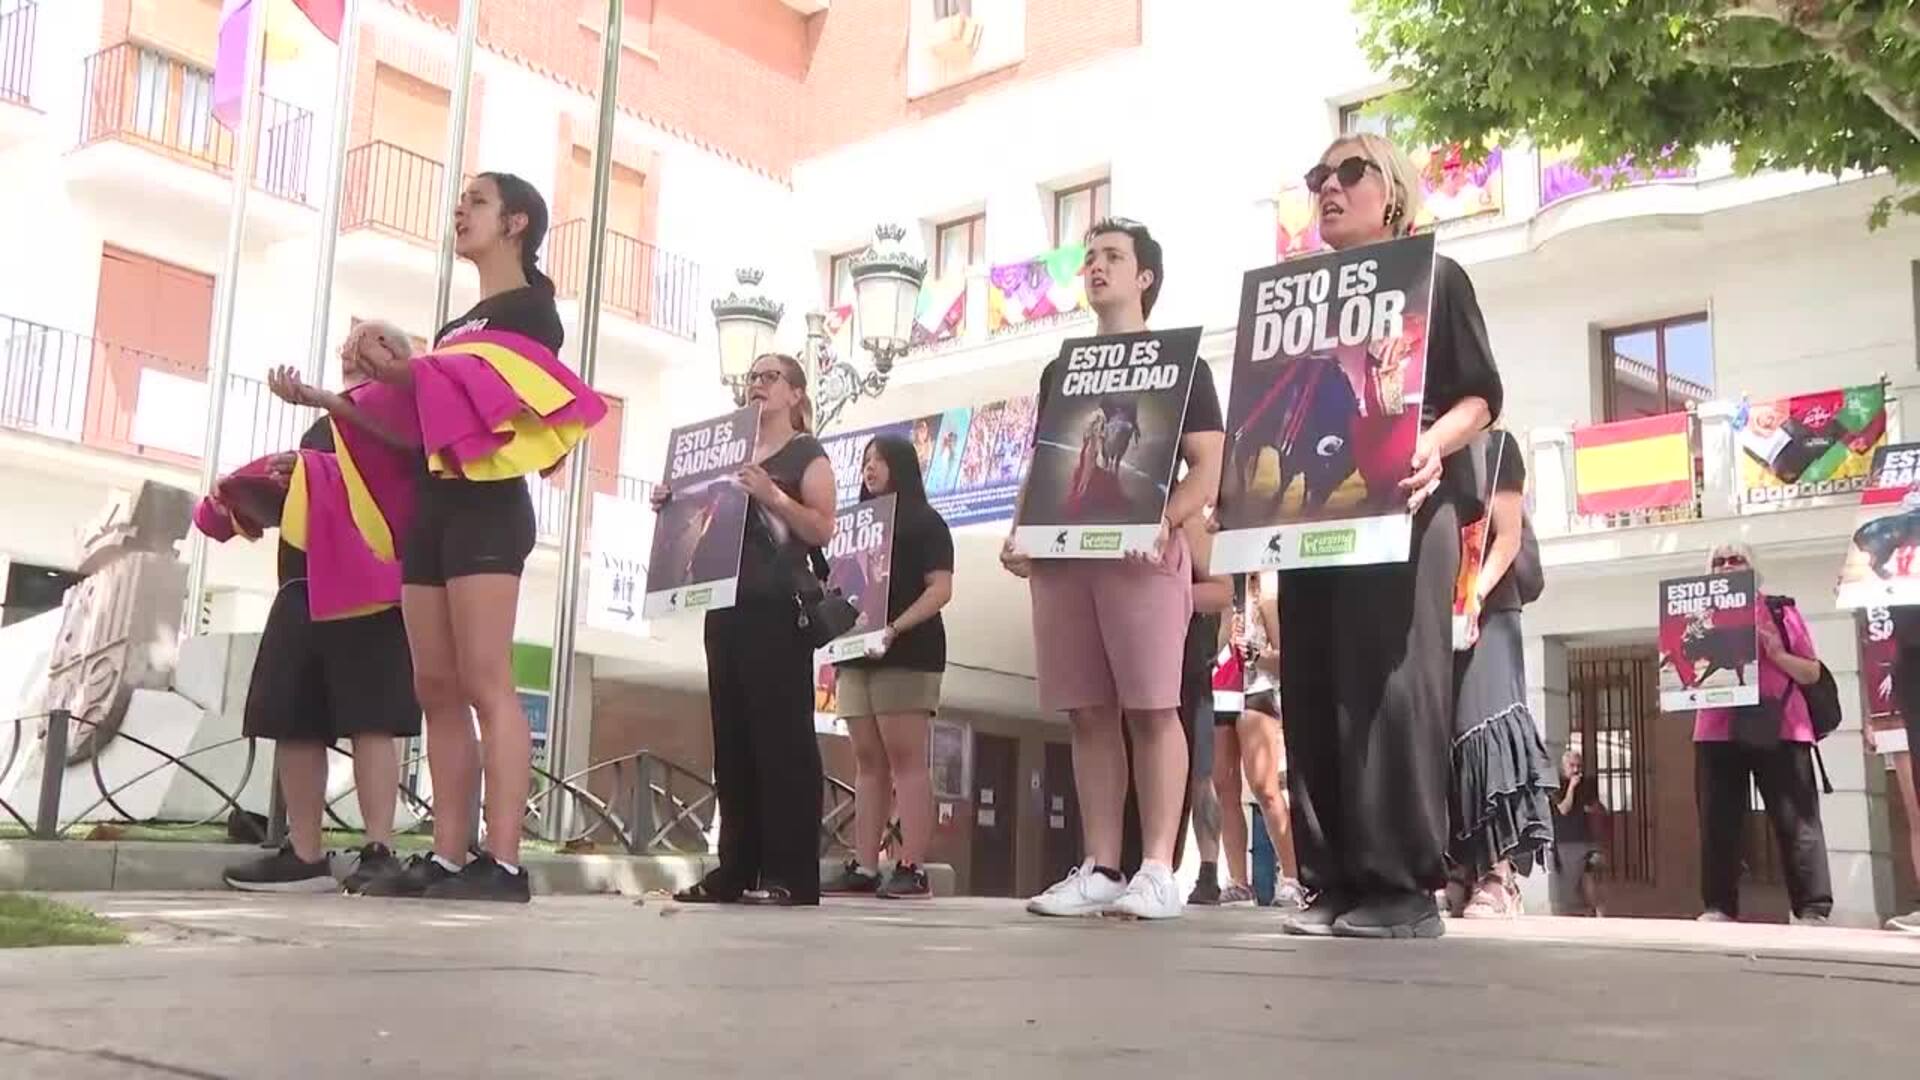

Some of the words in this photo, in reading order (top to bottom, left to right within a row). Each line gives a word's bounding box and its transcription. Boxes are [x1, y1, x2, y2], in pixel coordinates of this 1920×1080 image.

[1256, 269, 1330, 314] ESTO
[1338, 259, 1378, 298] ES
[1251, 290, 1405, 361] DOLOR
[1068, 343, 1125, 371] ESTO
[1129, 339, 1161, 366] ES
[1062, 364, 1179, 396] CRUELDAD
[674, 428, 711, 455] ESTO
[713, 421, 734, 445] ES
[671, 438, 746, 480] SADISMO
[856, 508, 873, 527] ES
[1667, 582, 1706, 601] ESTO
[1709, 579, 1730, 595] ES
